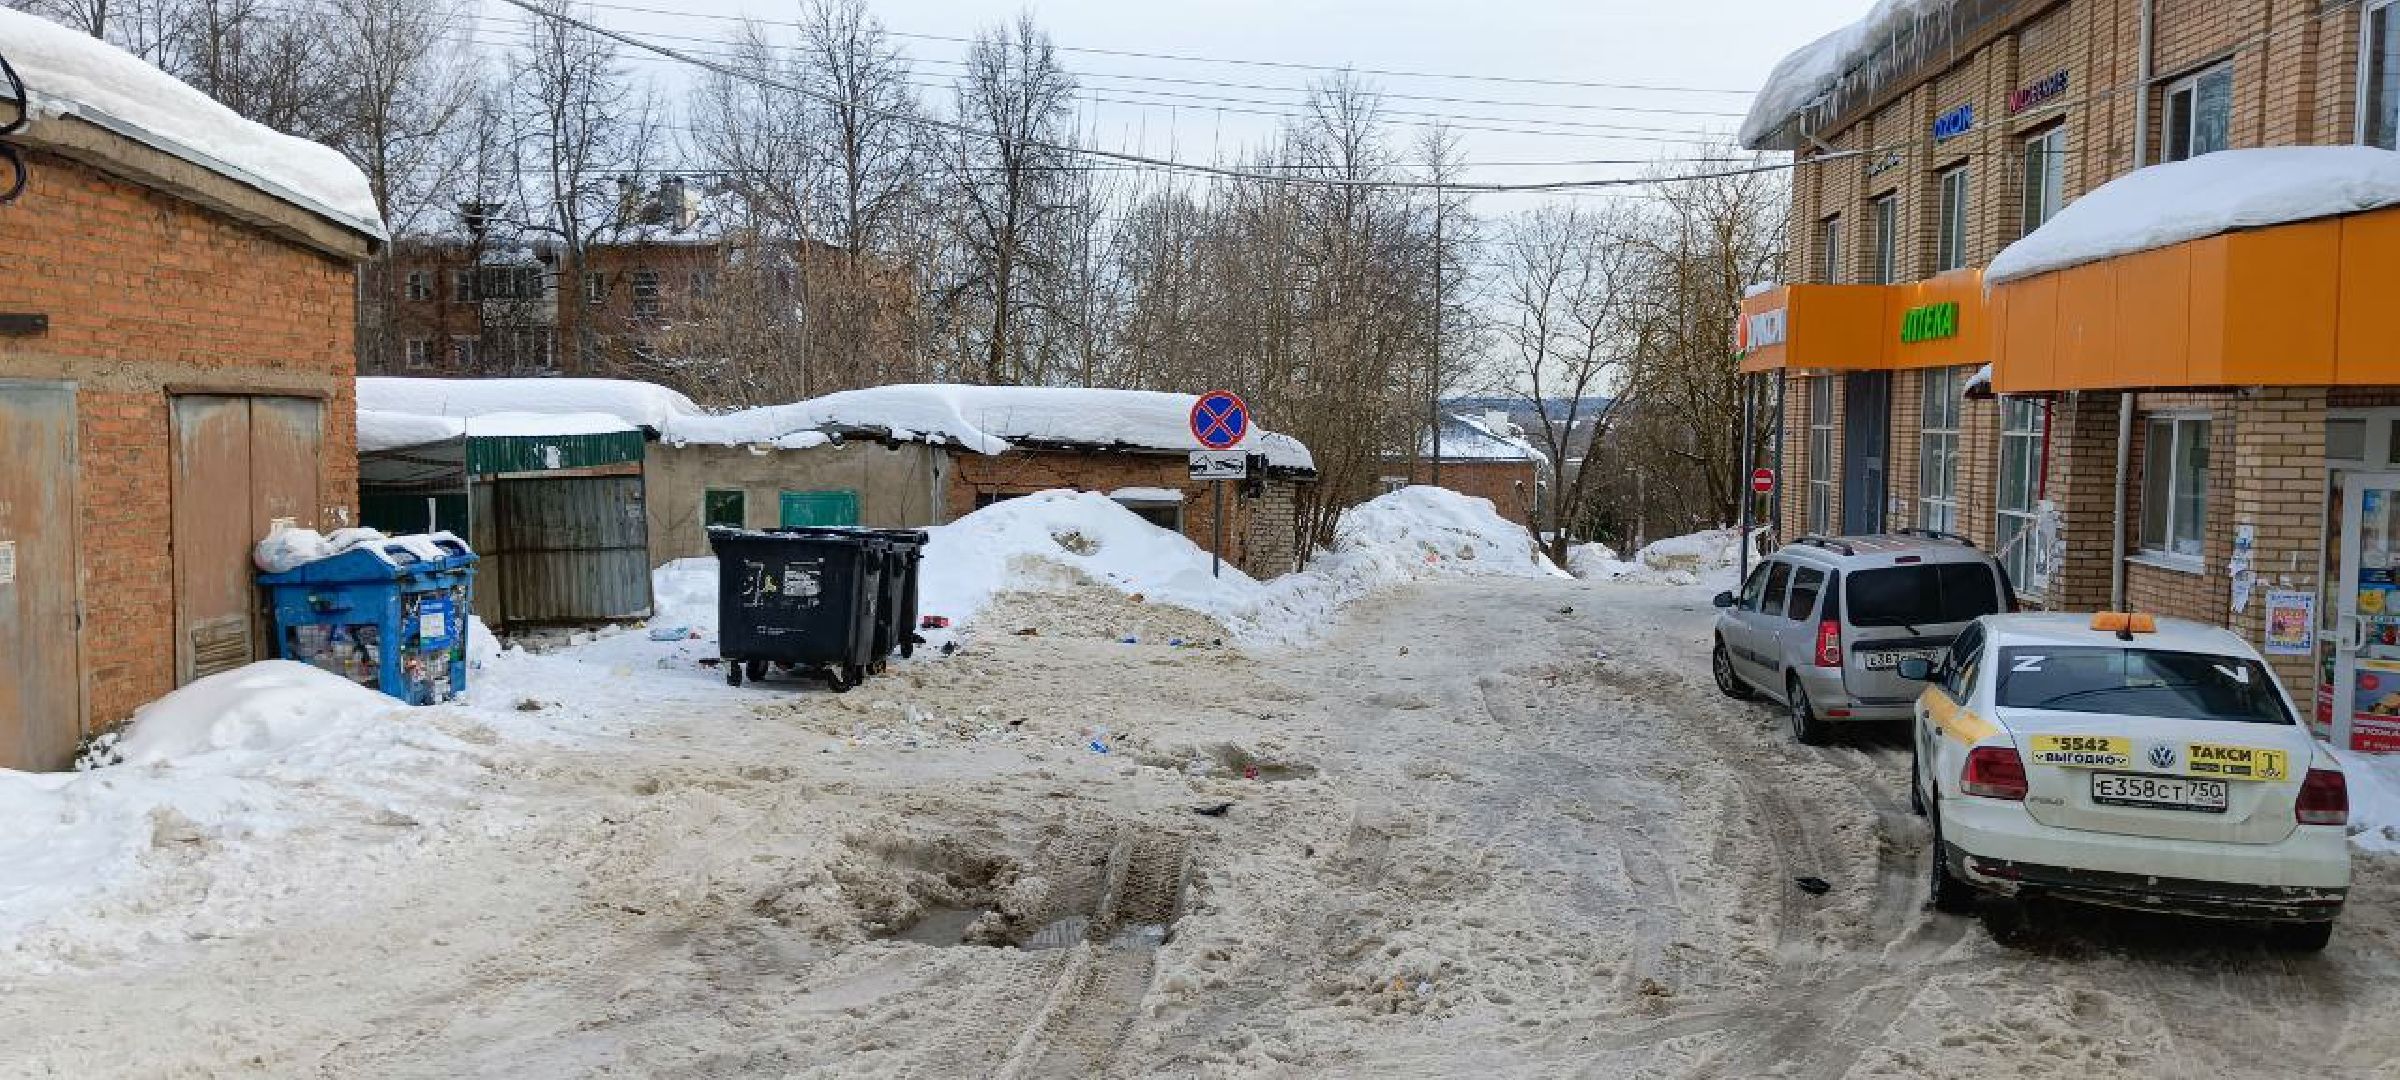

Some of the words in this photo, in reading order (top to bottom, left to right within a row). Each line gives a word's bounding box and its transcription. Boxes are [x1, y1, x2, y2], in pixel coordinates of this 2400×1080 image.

[1902, 303, 1957, 342] АПТЕКА
[2011, 655, 2046, 672] Z
[2046, 752, 2115, 765] ВЫГОДНО
[2190, 745, 2252, 762] ТАКСИ
